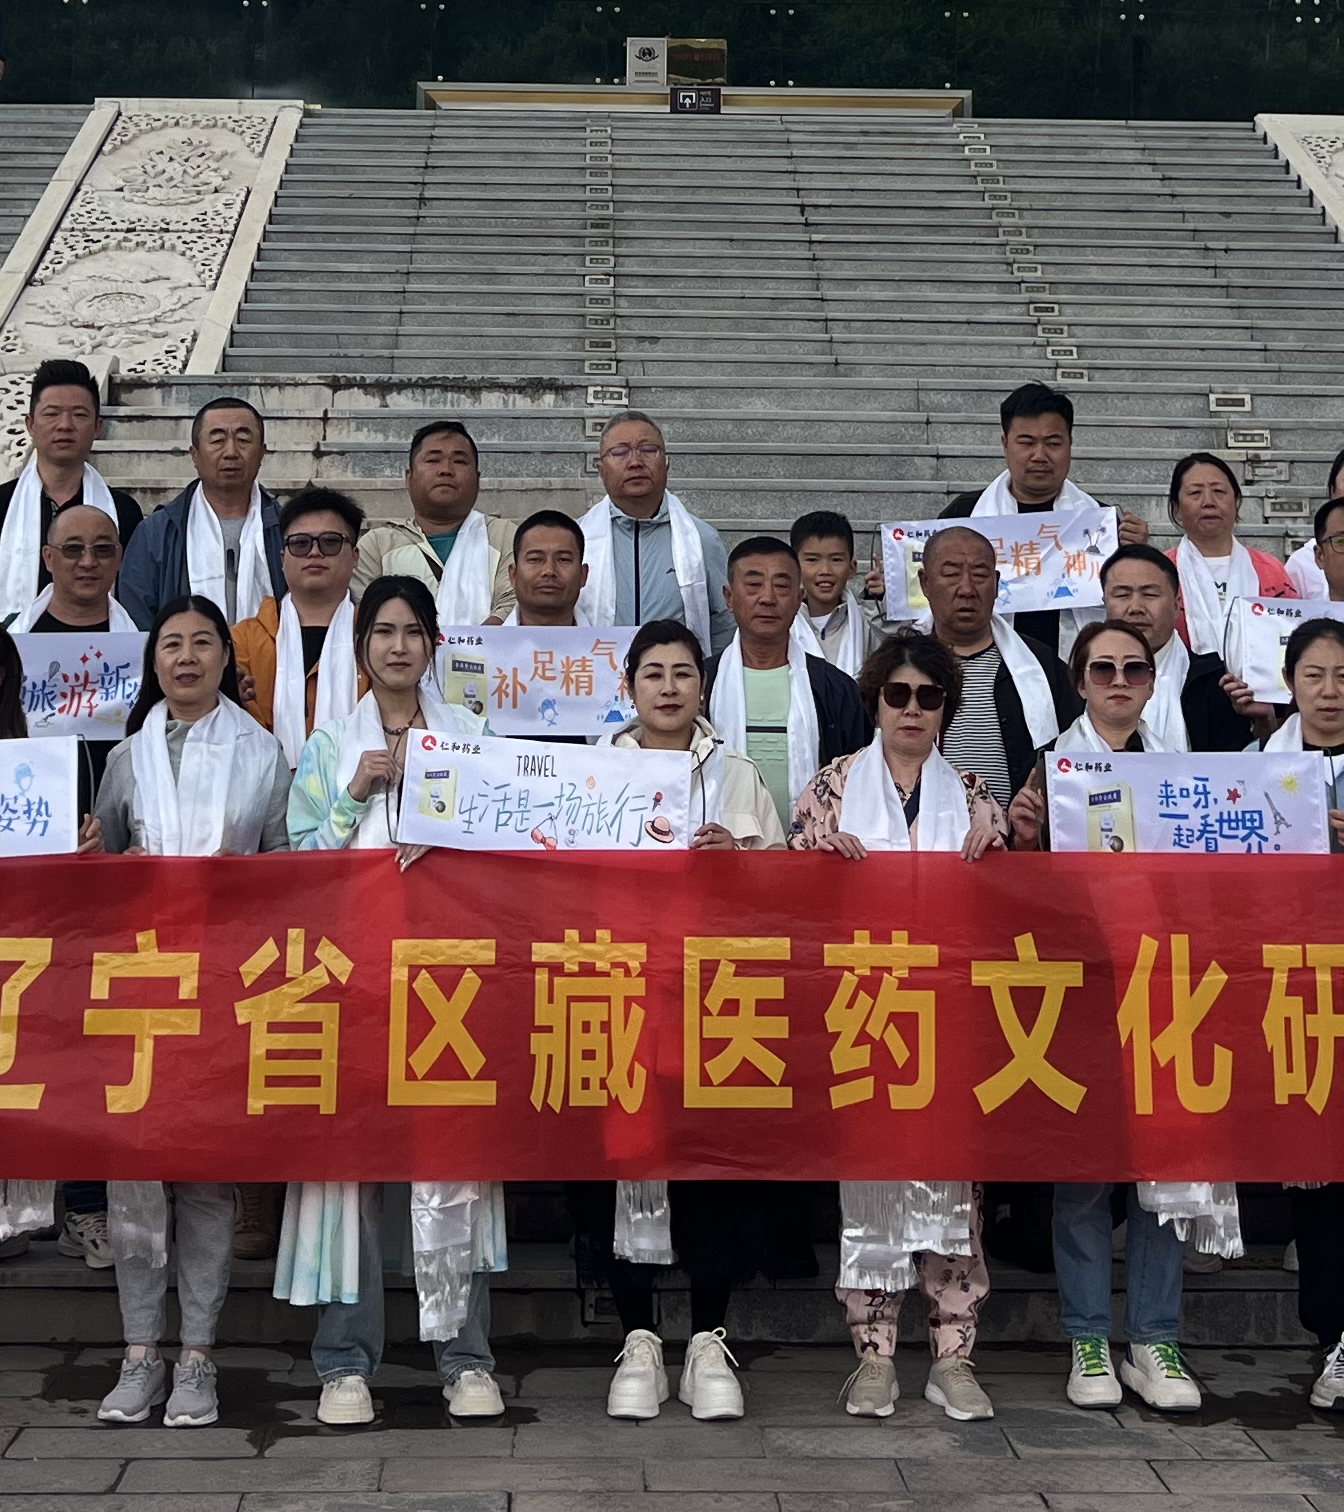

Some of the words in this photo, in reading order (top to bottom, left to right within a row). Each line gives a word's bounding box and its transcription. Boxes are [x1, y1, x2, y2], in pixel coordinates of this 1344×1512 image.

[1267, 606, 1303, 618] 仁和药业
[447, 635, 484, 647] 仁和药业
[440, 741, 482, 756] 仁和药业
[516, 754, 558, 778] TRAVEL
[1074, 761, 1113, 774] 仁和药业
[458, 779, 649, 848] 生活是一场旅行
